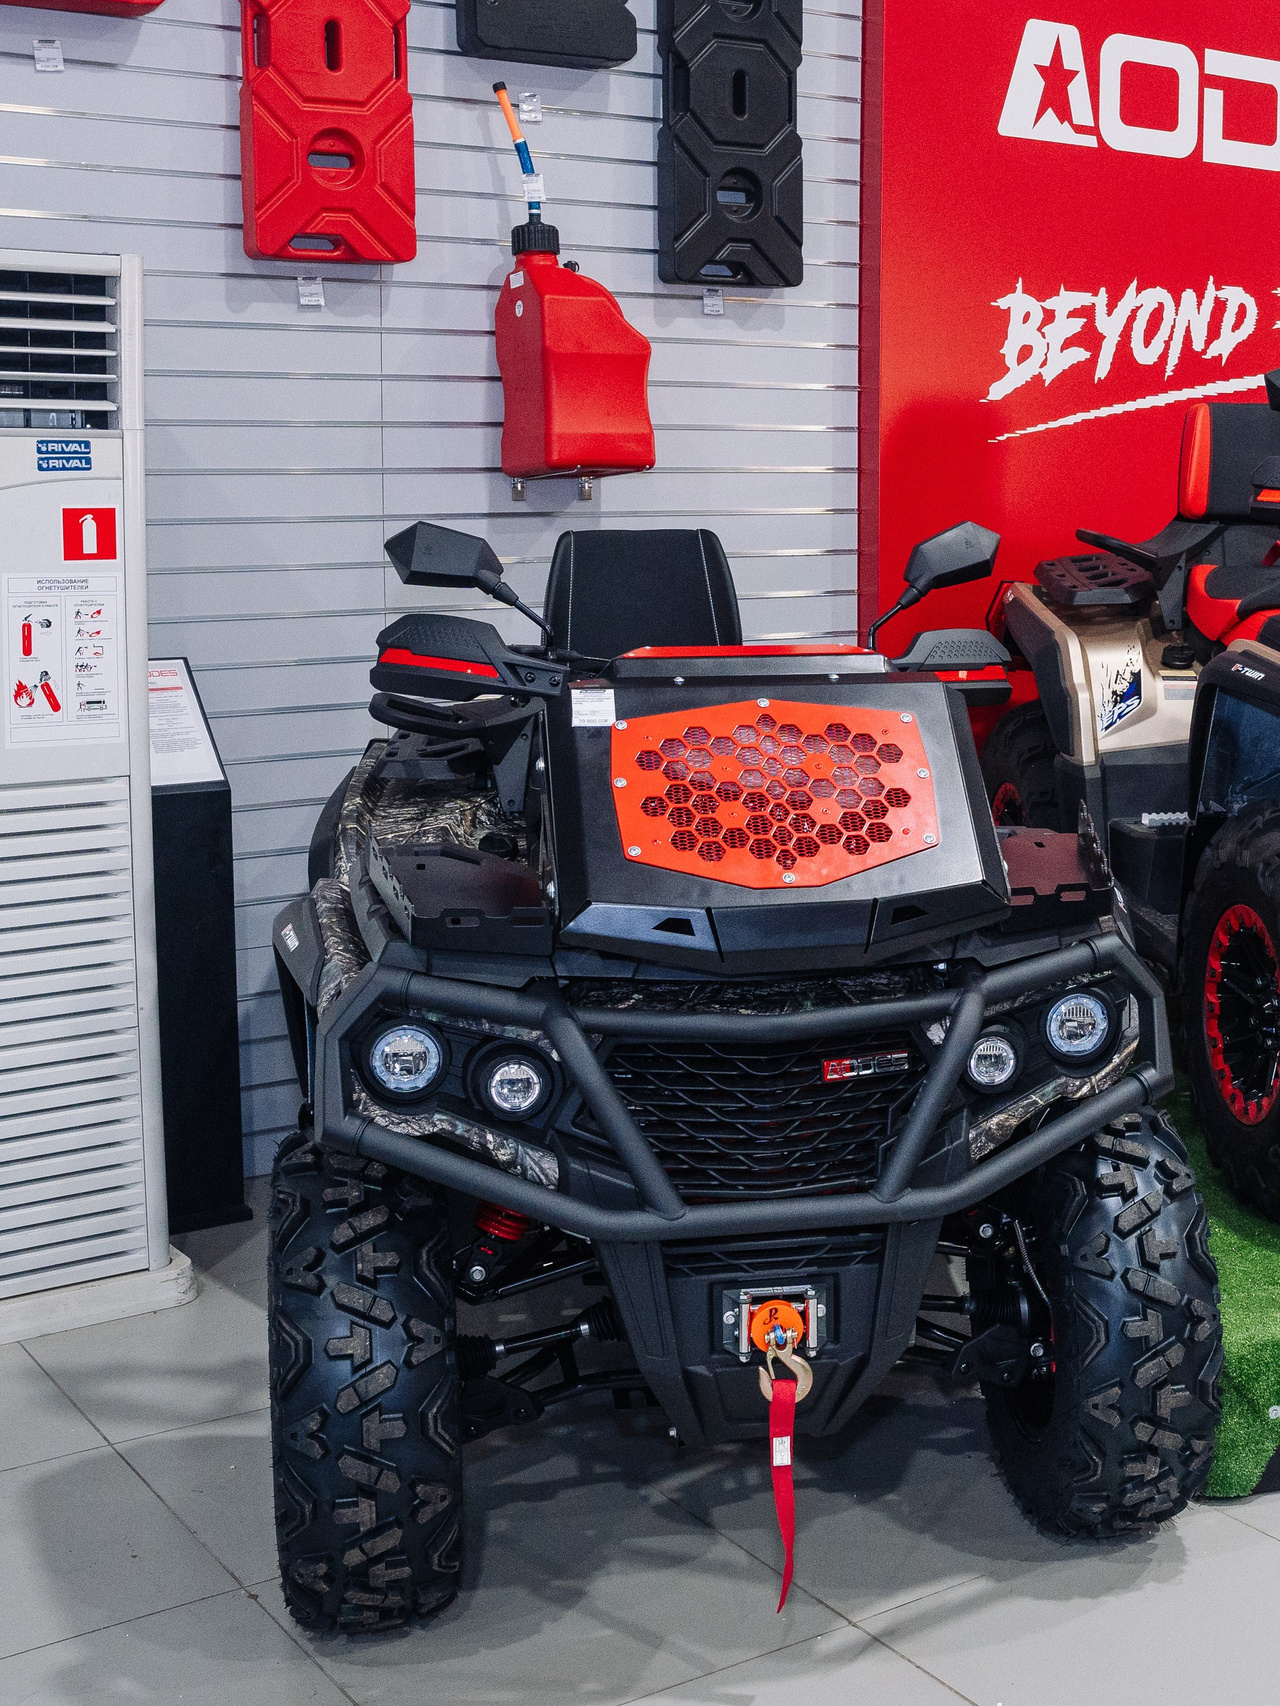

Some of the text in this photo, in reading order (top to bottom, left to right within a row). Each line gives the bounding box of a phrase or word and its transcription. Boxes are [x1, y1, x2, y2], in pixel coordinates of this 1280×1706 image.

[979, 274, 1258, 402] BEYOND
[48, 443, 90, 452] RIVAL
[49, 459, 91, 468] RIVAL
[1101, 695, 1141, 731] EPS
